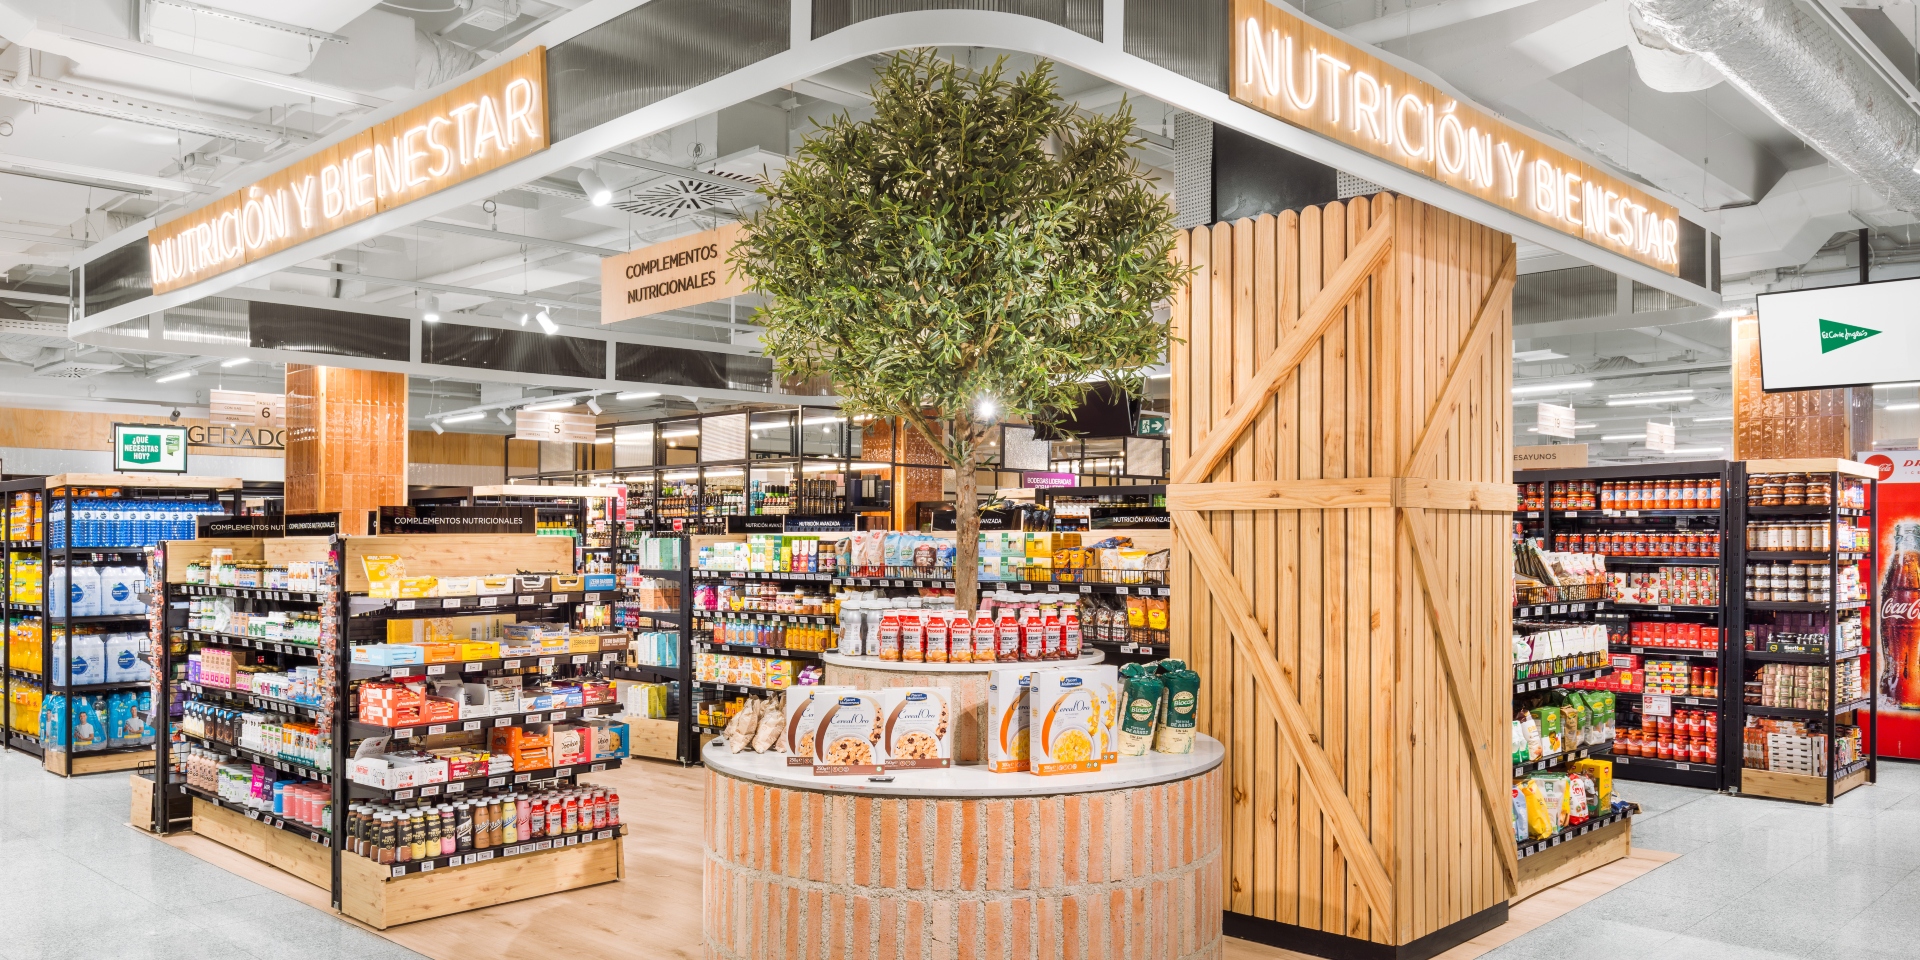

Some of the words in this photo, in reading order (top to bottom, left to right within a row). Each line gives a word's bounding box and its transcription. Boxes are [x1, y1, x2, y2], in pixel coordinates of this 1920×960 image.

[1244, 16, 1493, 189] NUTRICIÓN
[1499, 139, 1525, 199] Y
[1534, 158, 1679, 266] BIENESTAR
[150, 186, 287, 285] NUTRICIÓN
[291, 174, 315, 229] Y
[320, 77, 542, 220] BIENESTAR
[625, 243, 718, 280] COMPLEMENTOS
[627, 270, 716, 304] NUTRICIONALES
[262, 407, 270, 418] 6
[554, 424, 560, 434] 5
[132, 434, 149, 445] ¿QUÉ
[124, 444, 159, 453] NECESITAS
[133, 452, 150, 460] HOY?
[1513, 453, 1557, 461] ESAYUNOS
